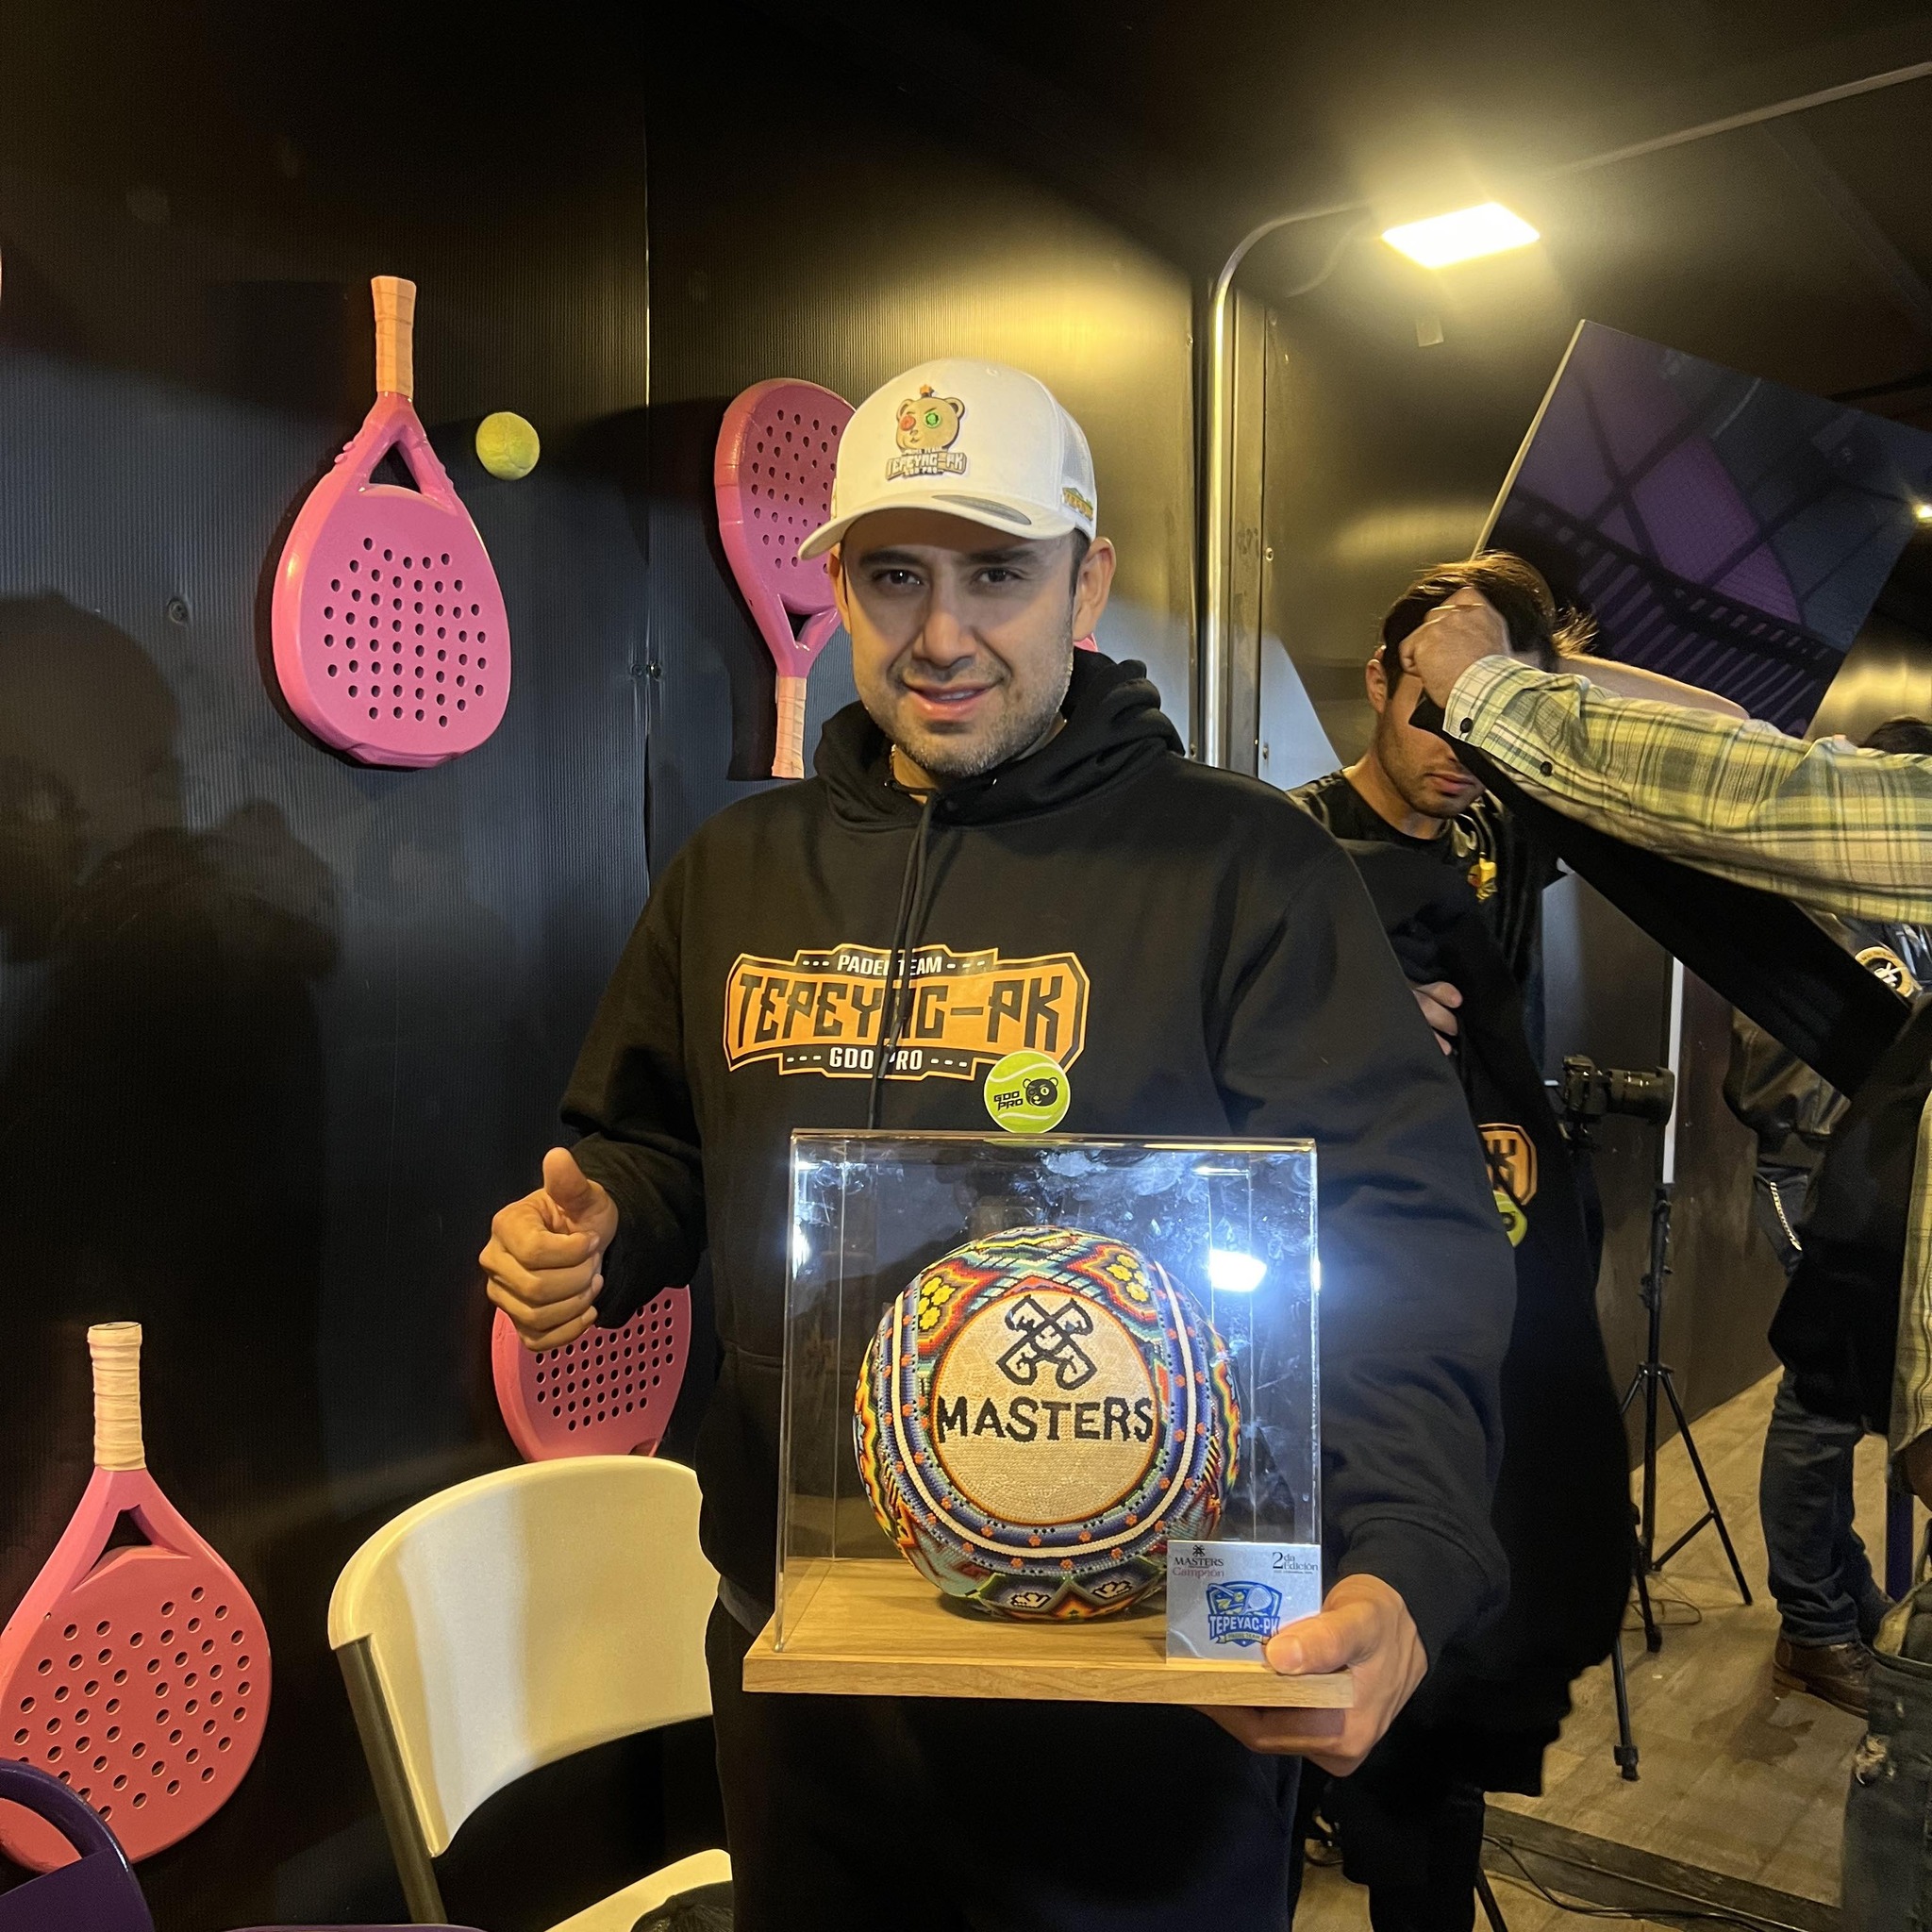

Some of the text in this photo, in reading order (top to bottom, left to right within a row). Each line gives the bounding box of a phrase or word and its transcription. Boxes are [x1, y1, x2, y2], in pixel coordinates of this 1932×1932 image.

[738, 974, 1063, 1053] TEPEYC-PK
[829, 1046, 923, 1071] GDO RO
[998, 1098, 1024, 1111] PRO
[937, 1395, 1153, 1443] MASTERS
[1174, 1557, 1224, 1566] MASTERS
